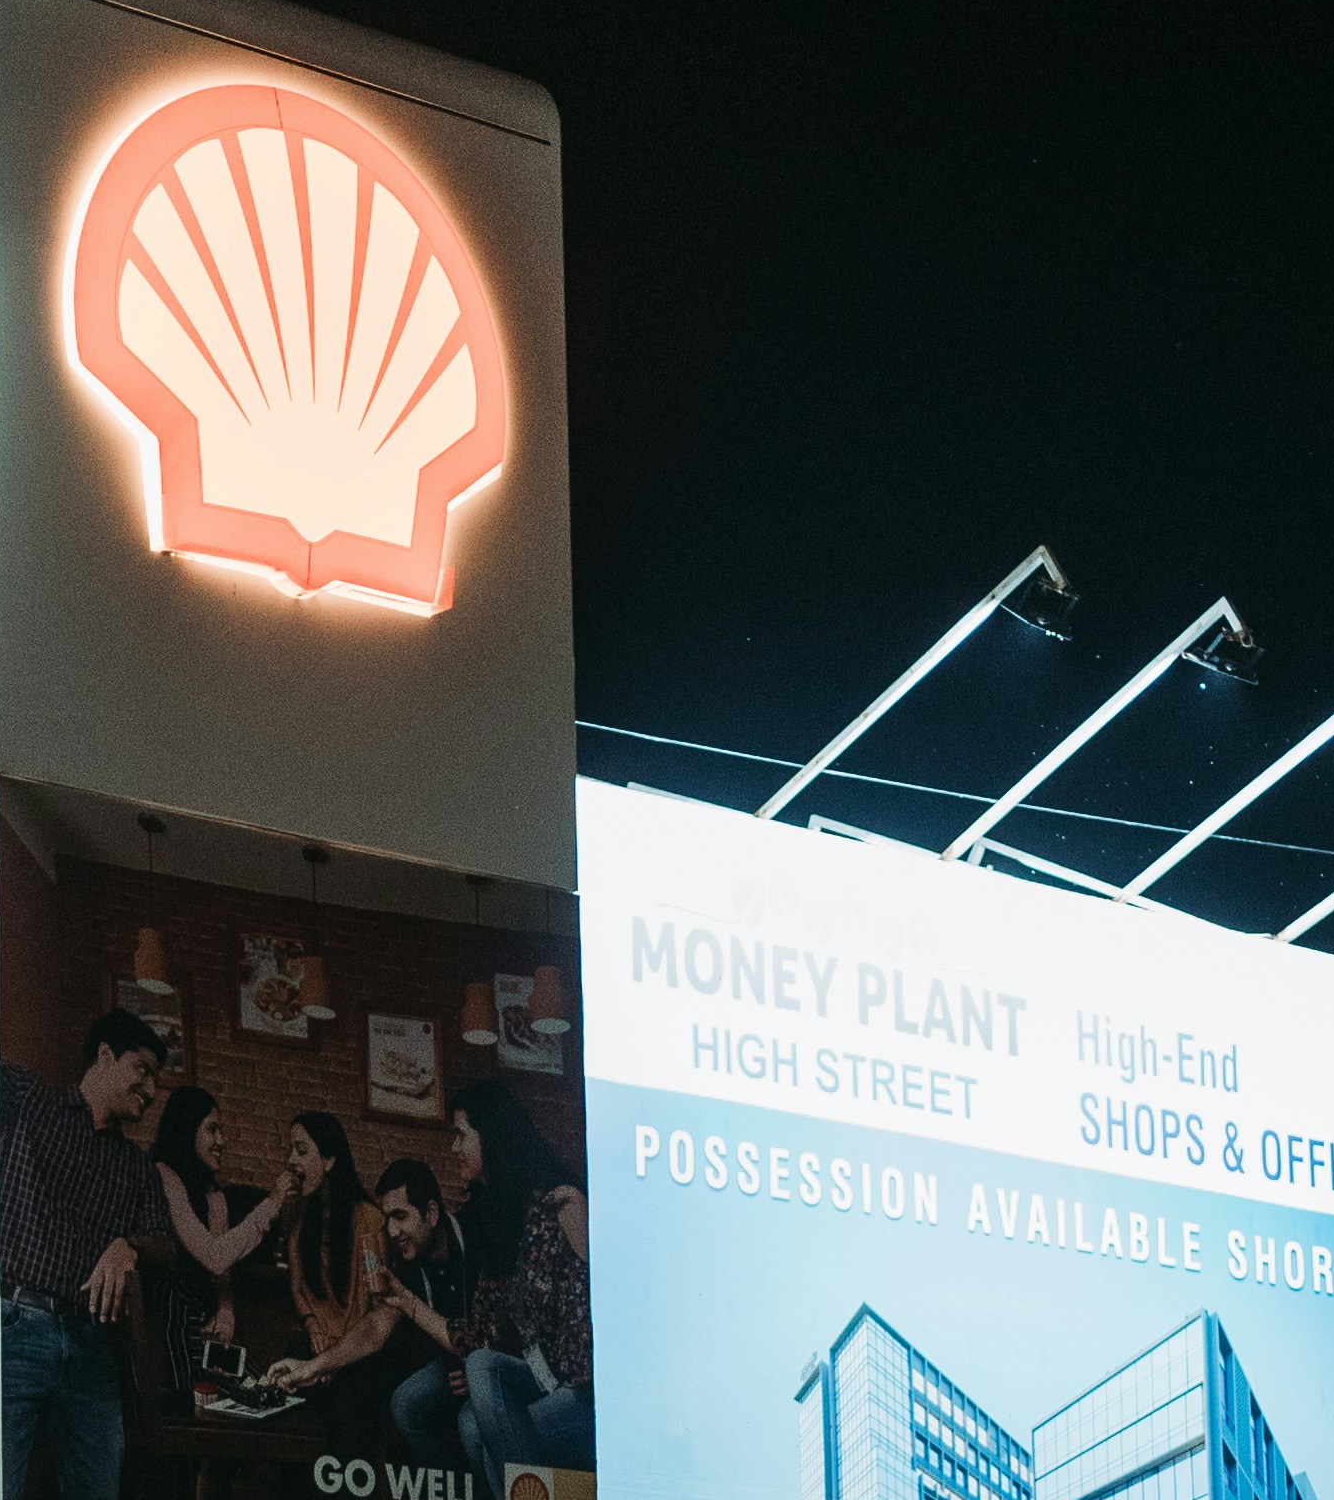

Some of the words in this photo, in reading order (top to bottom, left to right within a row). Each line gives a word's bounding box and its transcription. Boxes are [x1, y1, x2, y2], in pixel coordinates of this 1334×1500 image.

[632, 916, 838, 1018] MONEY
[858, 960, 1028, 1057] PLANT
[691, 1022, 800, 1087] HIGH
[815, 1047, 978, 1120] STREET
[1075, 1010, 1240, 1094] High-End
[1080, 1091, 1206, 1167] SHOPS
[1222, 1123, 1247, 1176] &
[633, 1124, 939, 1227] POSSESSION
[968, 1182, 1203, 1274] AVAILABLE
[313, 1455, 376, 1498] GO
